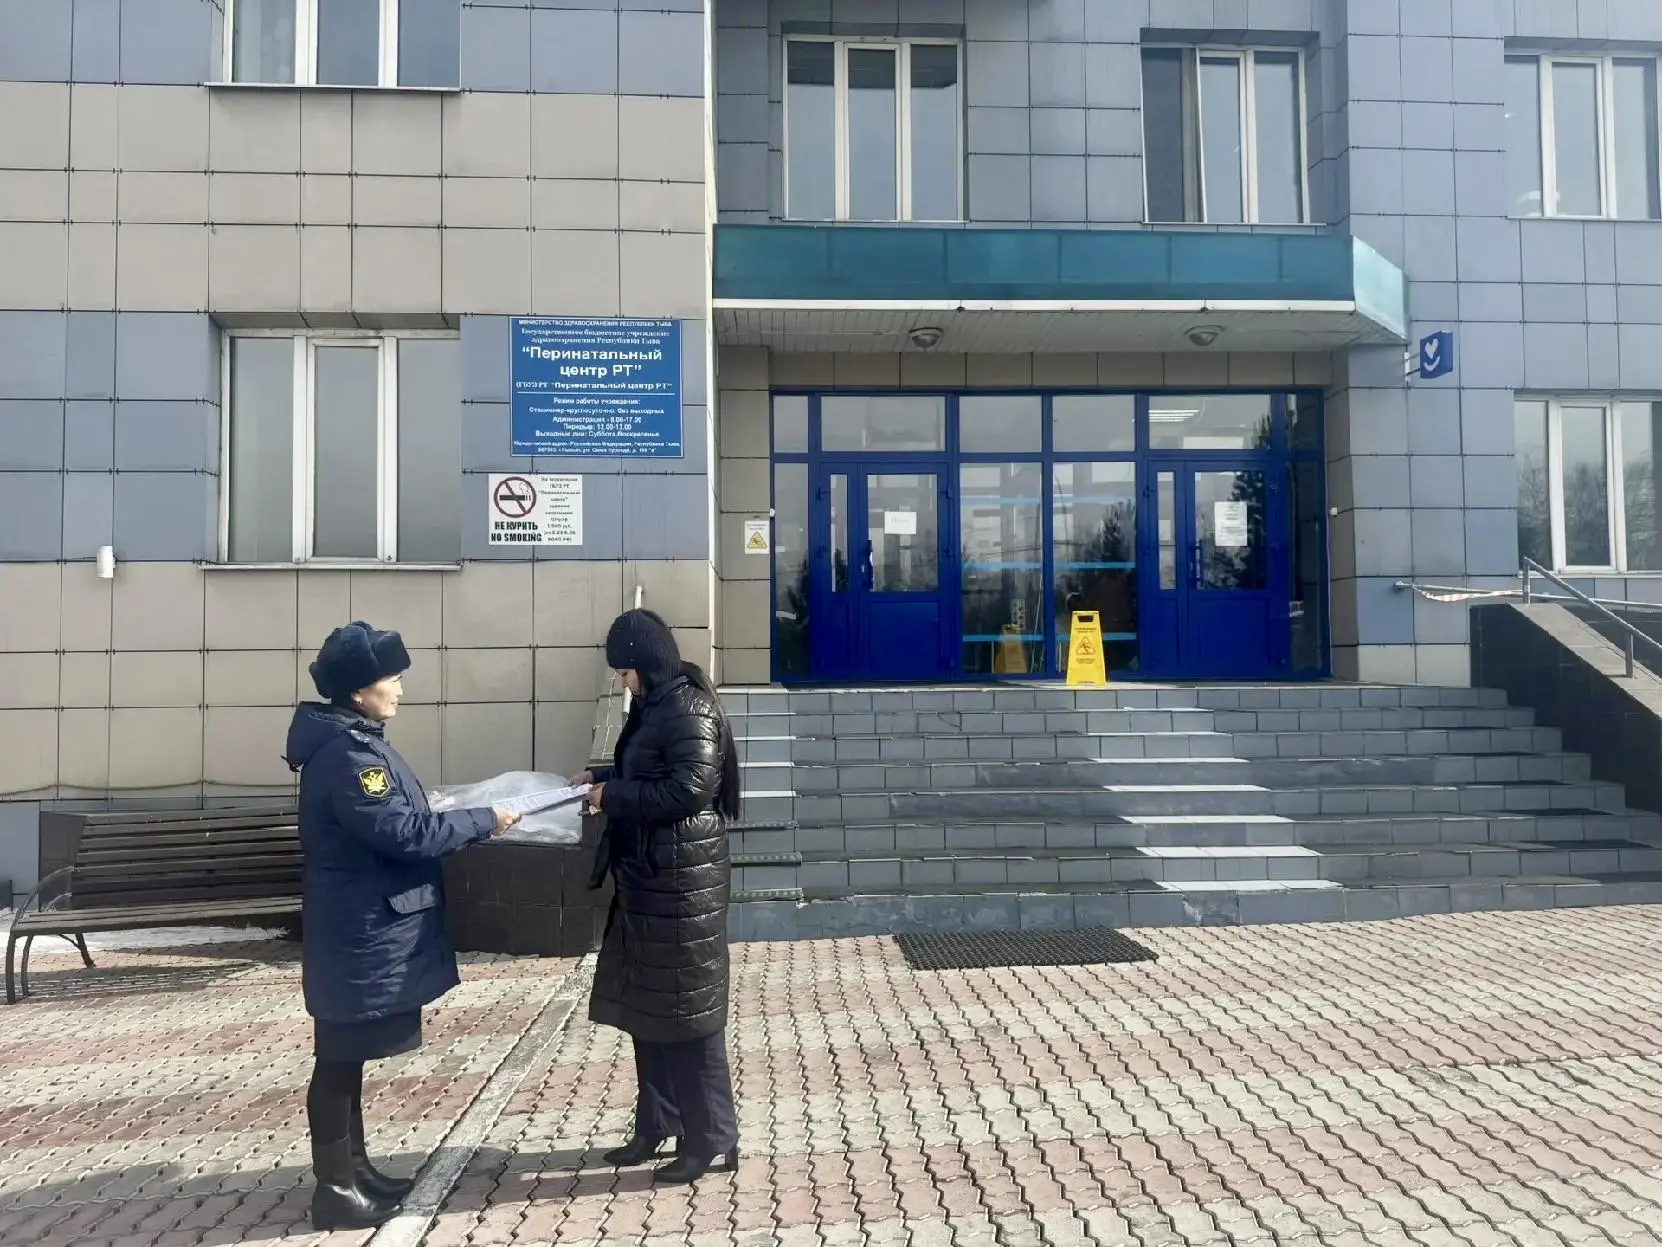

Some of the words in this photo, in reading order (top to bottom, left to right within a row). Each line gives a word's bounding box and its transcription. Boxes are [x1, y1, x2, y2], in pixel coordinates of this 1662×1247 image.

[560, 366, 608, 378] центр
[494, 521, 504, 530] НЕ
[506, 521, 538, 530] КУРИТЬ
[490, 533, 502, 542] NO
[504, 532, 542, 542] SMOKING
